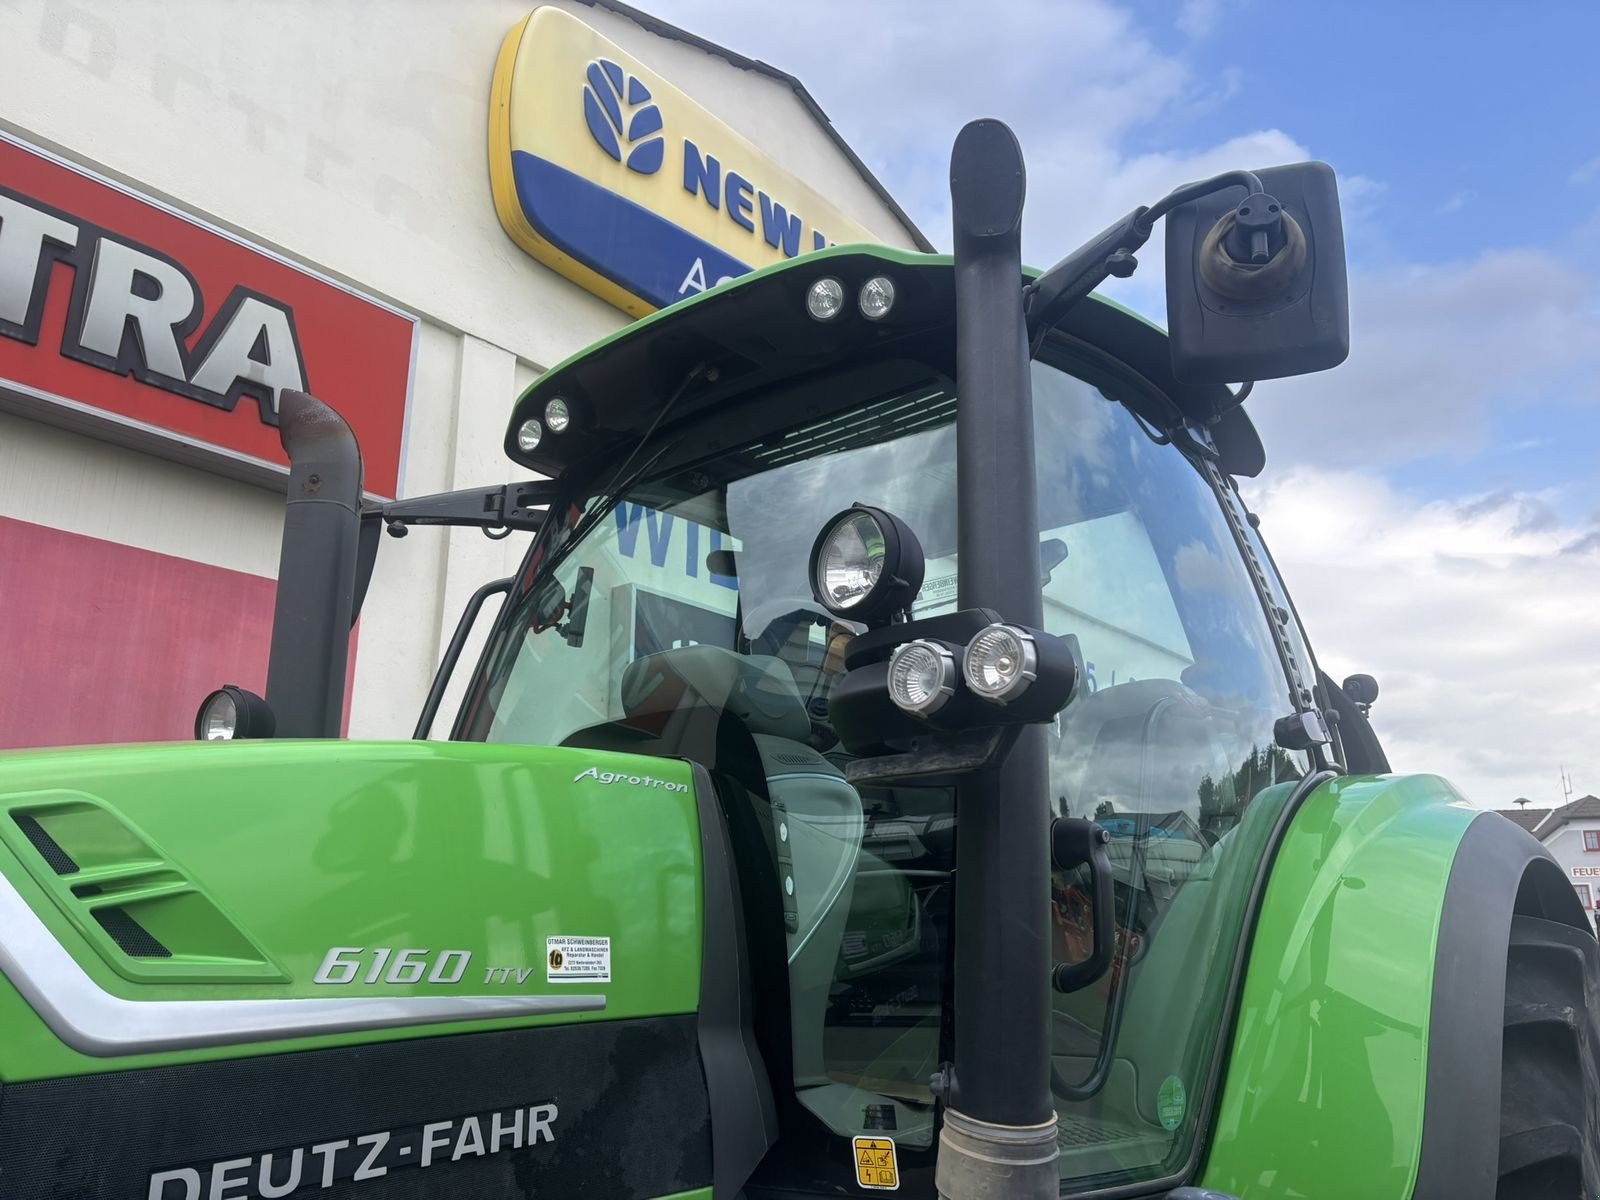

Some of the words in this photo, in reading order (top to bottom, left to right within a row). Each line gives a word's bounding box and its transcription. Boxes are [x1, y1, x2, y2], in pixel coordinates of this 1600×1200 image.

[682, 138, 802, 258] NEW
[0, 193, 305, 415] TRA
[574, 767, 688, 793] Agrotron
[312, 946, 474, 985] 6160
[484, 967, 534, 984] TTV
[147, 1103, 559, 1200] DEUTZ-FAHR
